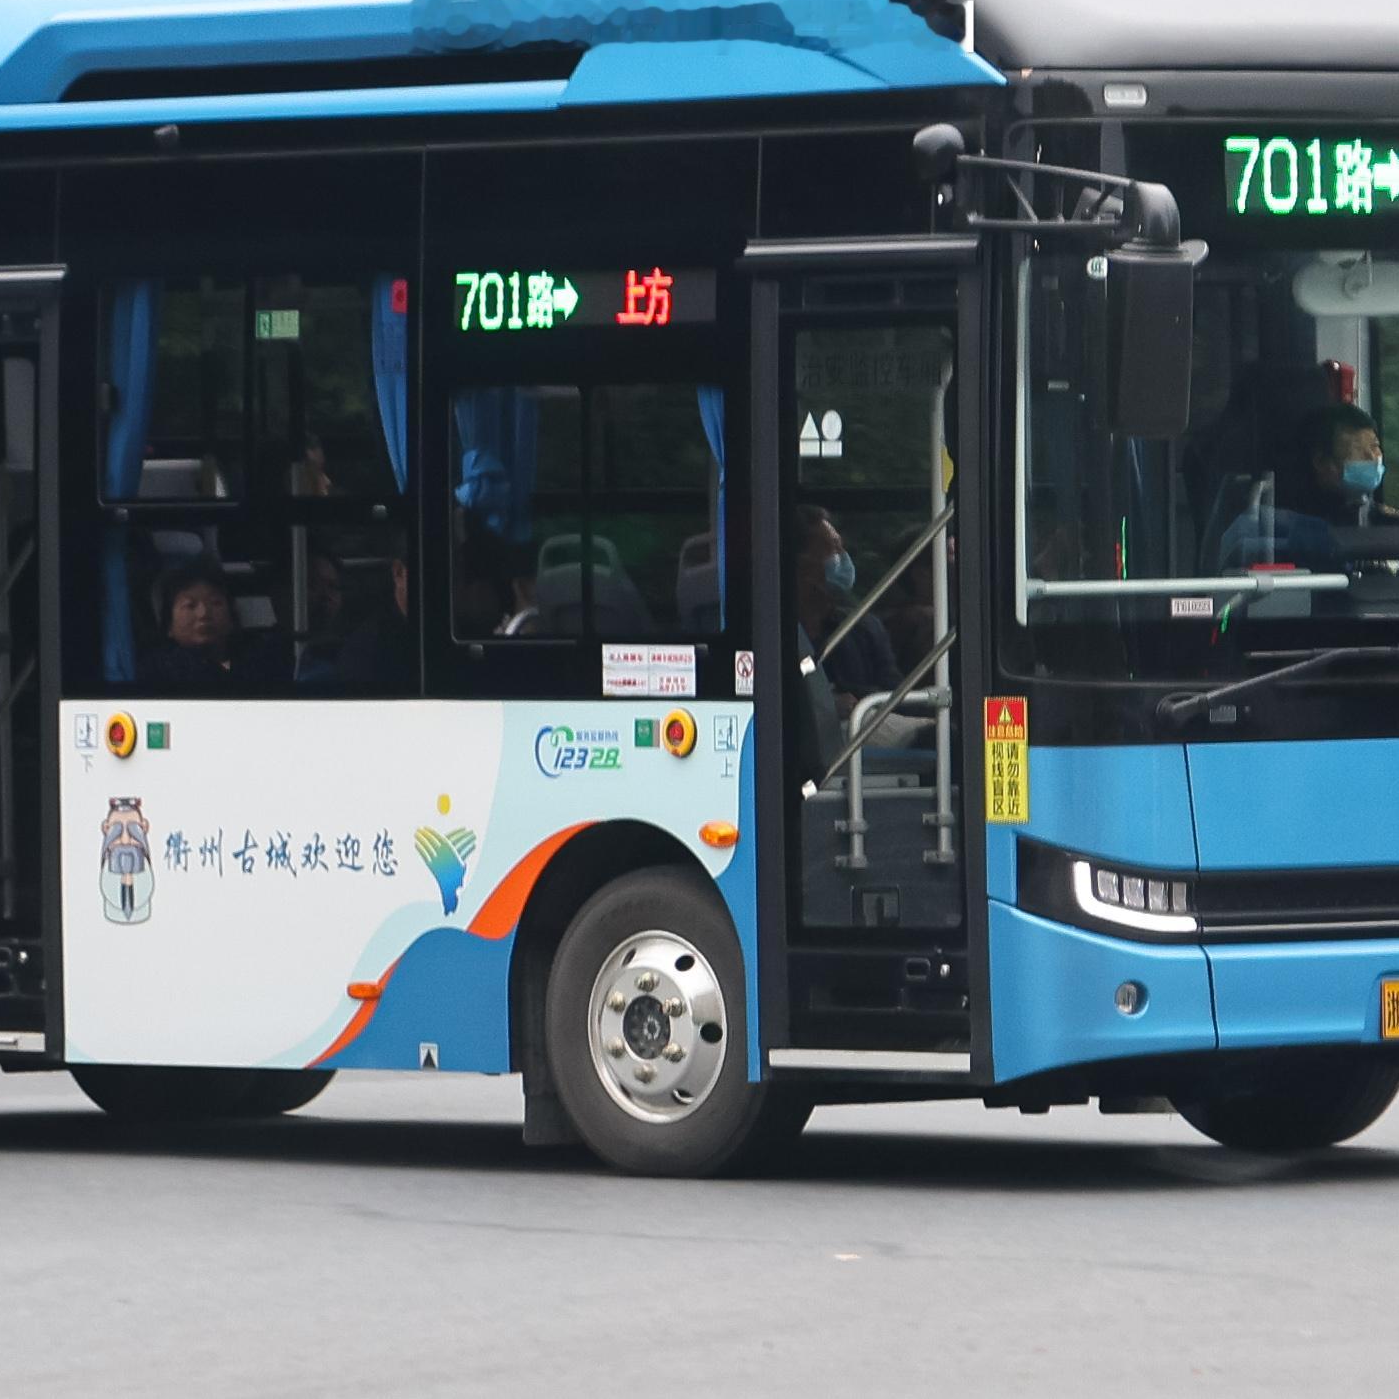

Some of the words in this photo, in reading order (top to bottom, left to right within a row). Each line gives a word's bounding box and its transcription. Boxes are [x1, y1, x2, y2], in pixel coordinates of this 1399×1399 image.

[1224, 137, 1373, 214] 701路
[455, 270, 553, 330] 701路
[615, 266, 673, 325] 上方
[164, 826, 399, 878] 衢州古城欢迎您
